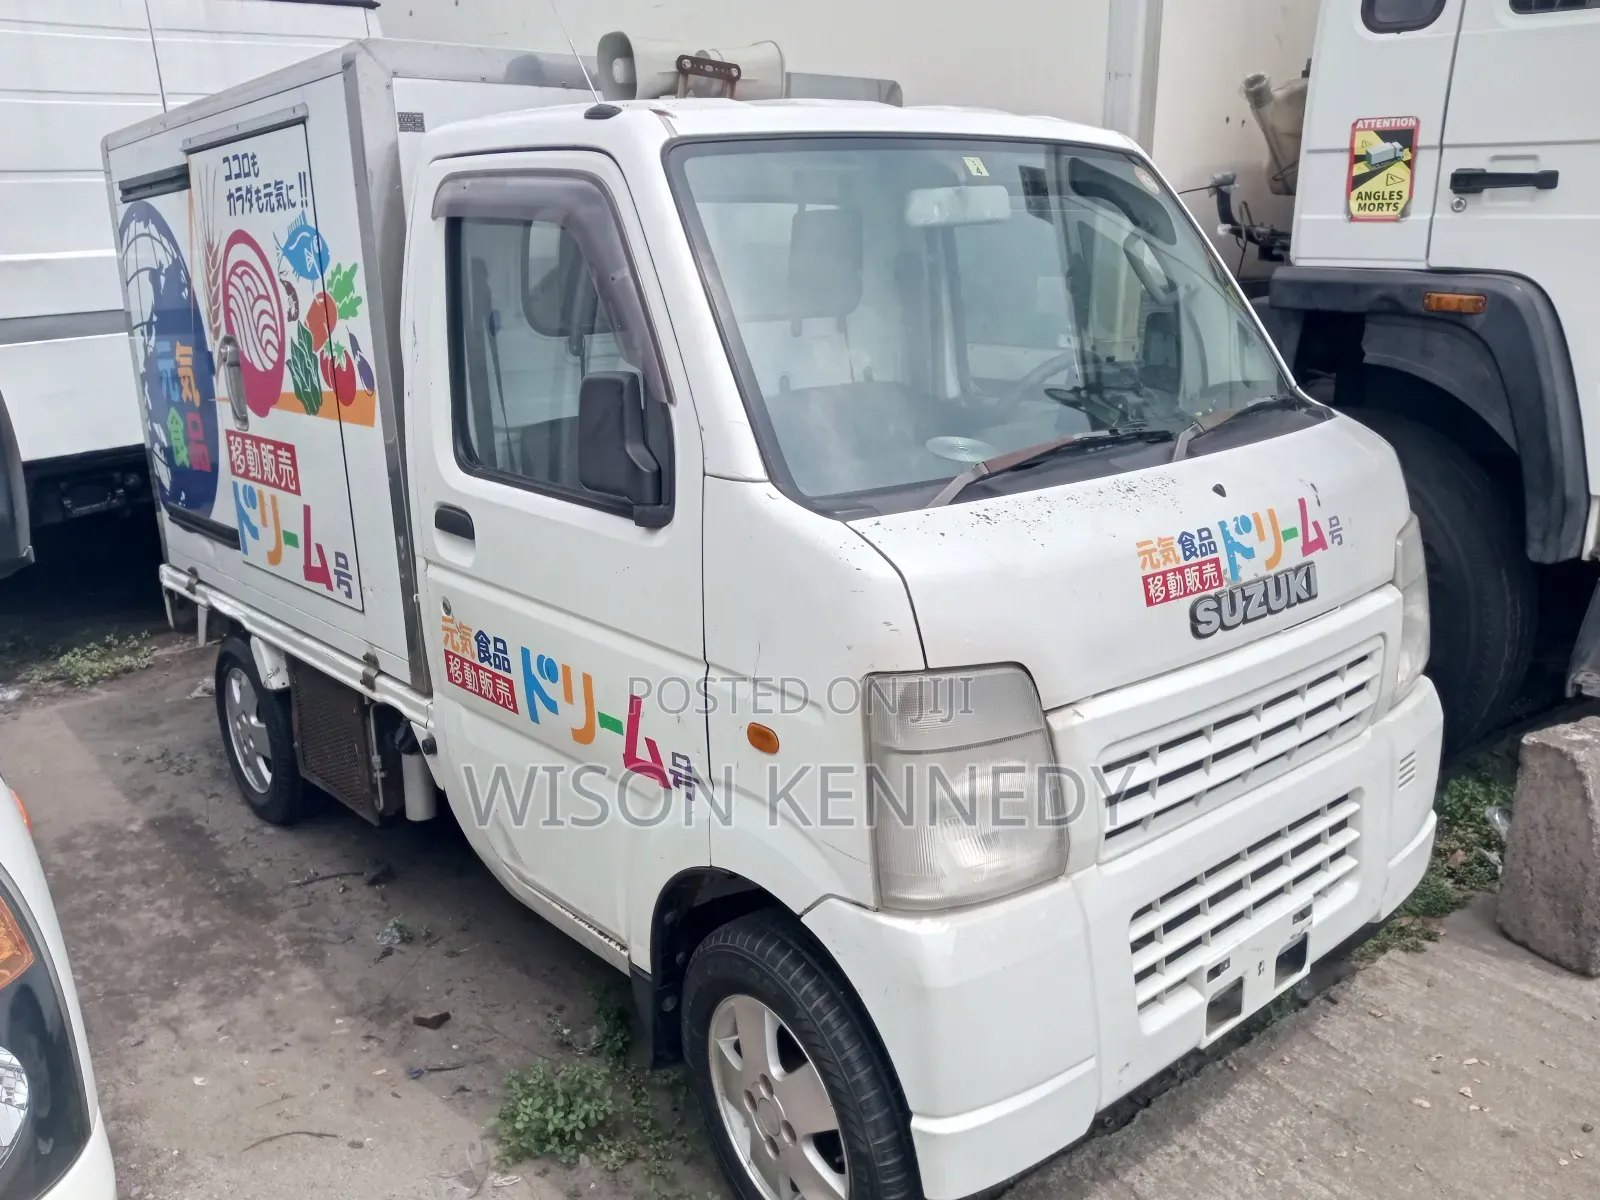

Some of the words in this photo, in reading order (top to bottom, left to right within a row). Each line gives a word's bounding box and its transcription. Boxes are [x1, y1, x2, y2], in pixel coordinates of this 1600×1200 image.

[1356, 117, 1416, 129] ATTENTION
[222, 151, 260, 182] ココロも
[1356, 190, 1403, 201] ANGLES
[1357, 202, 1399, 212] MORTS
[155, 340, 200, 407] 元気
[229, 435, 297, 491] 移動販売
[232, 480, 353, 600] ドリーム号
[1136, 527, 1218, 570] 元気食品
[1217, 497, 1344, 583] ドリーム号
[1147, 563, 1220, 604] 移動販売
[1189, 560, 1319, 640] SUZUKI
[441, 615, 512, 674] 元気食品
[448, 654, 514, 711] 移動販売
[520, 645, 700, 802] ドリーム号
